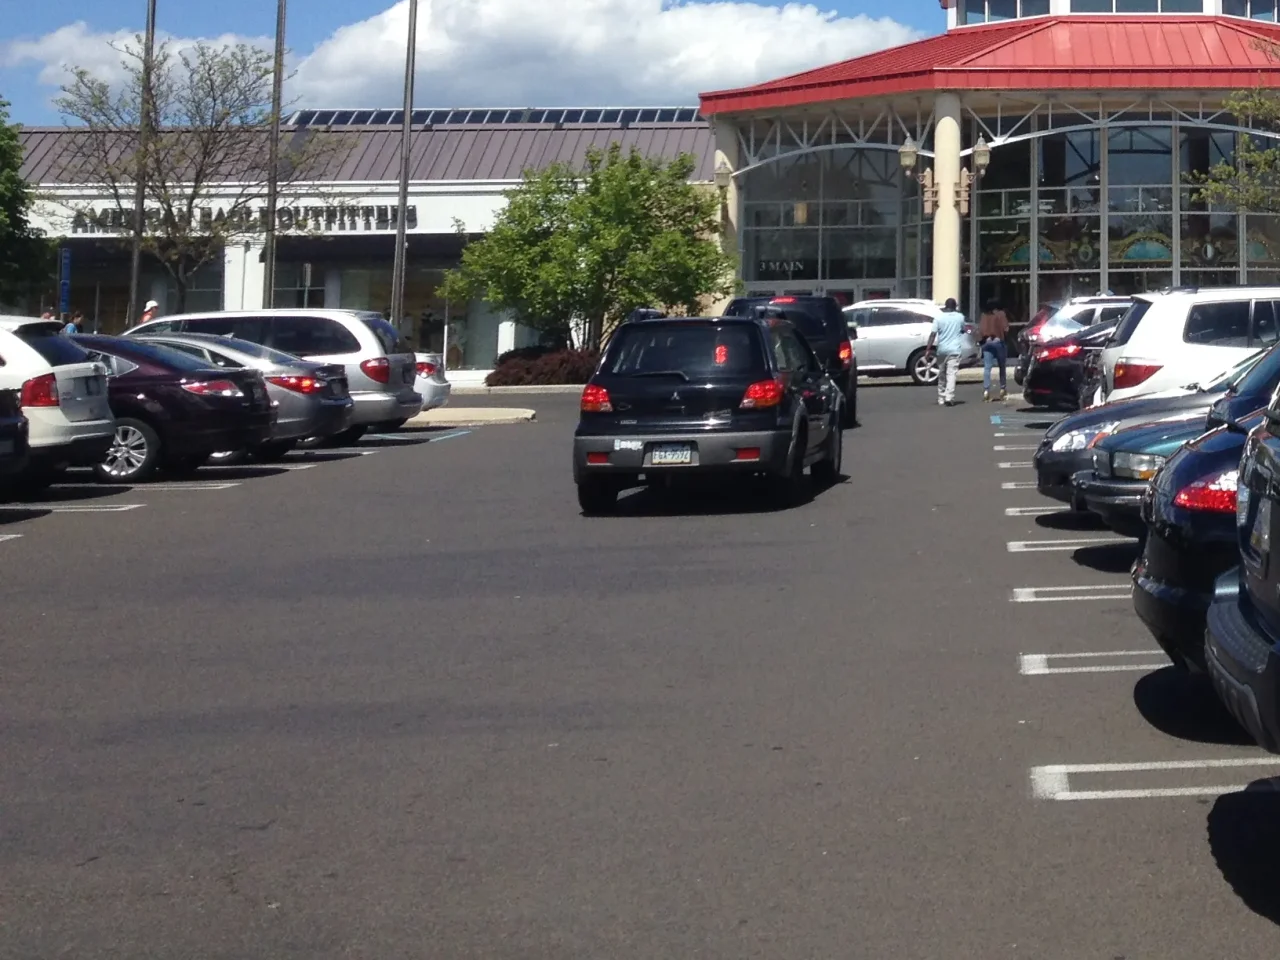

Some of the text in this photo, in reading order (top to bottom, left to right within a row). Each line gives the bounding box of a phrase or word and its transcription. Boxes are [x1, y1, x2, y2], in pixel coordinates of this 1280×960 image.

[71, 207, 193, 234] AMERCAN
[277, 205, 417, 230] OUTFITTERS
[769, 260, 804, 271] MAIN
